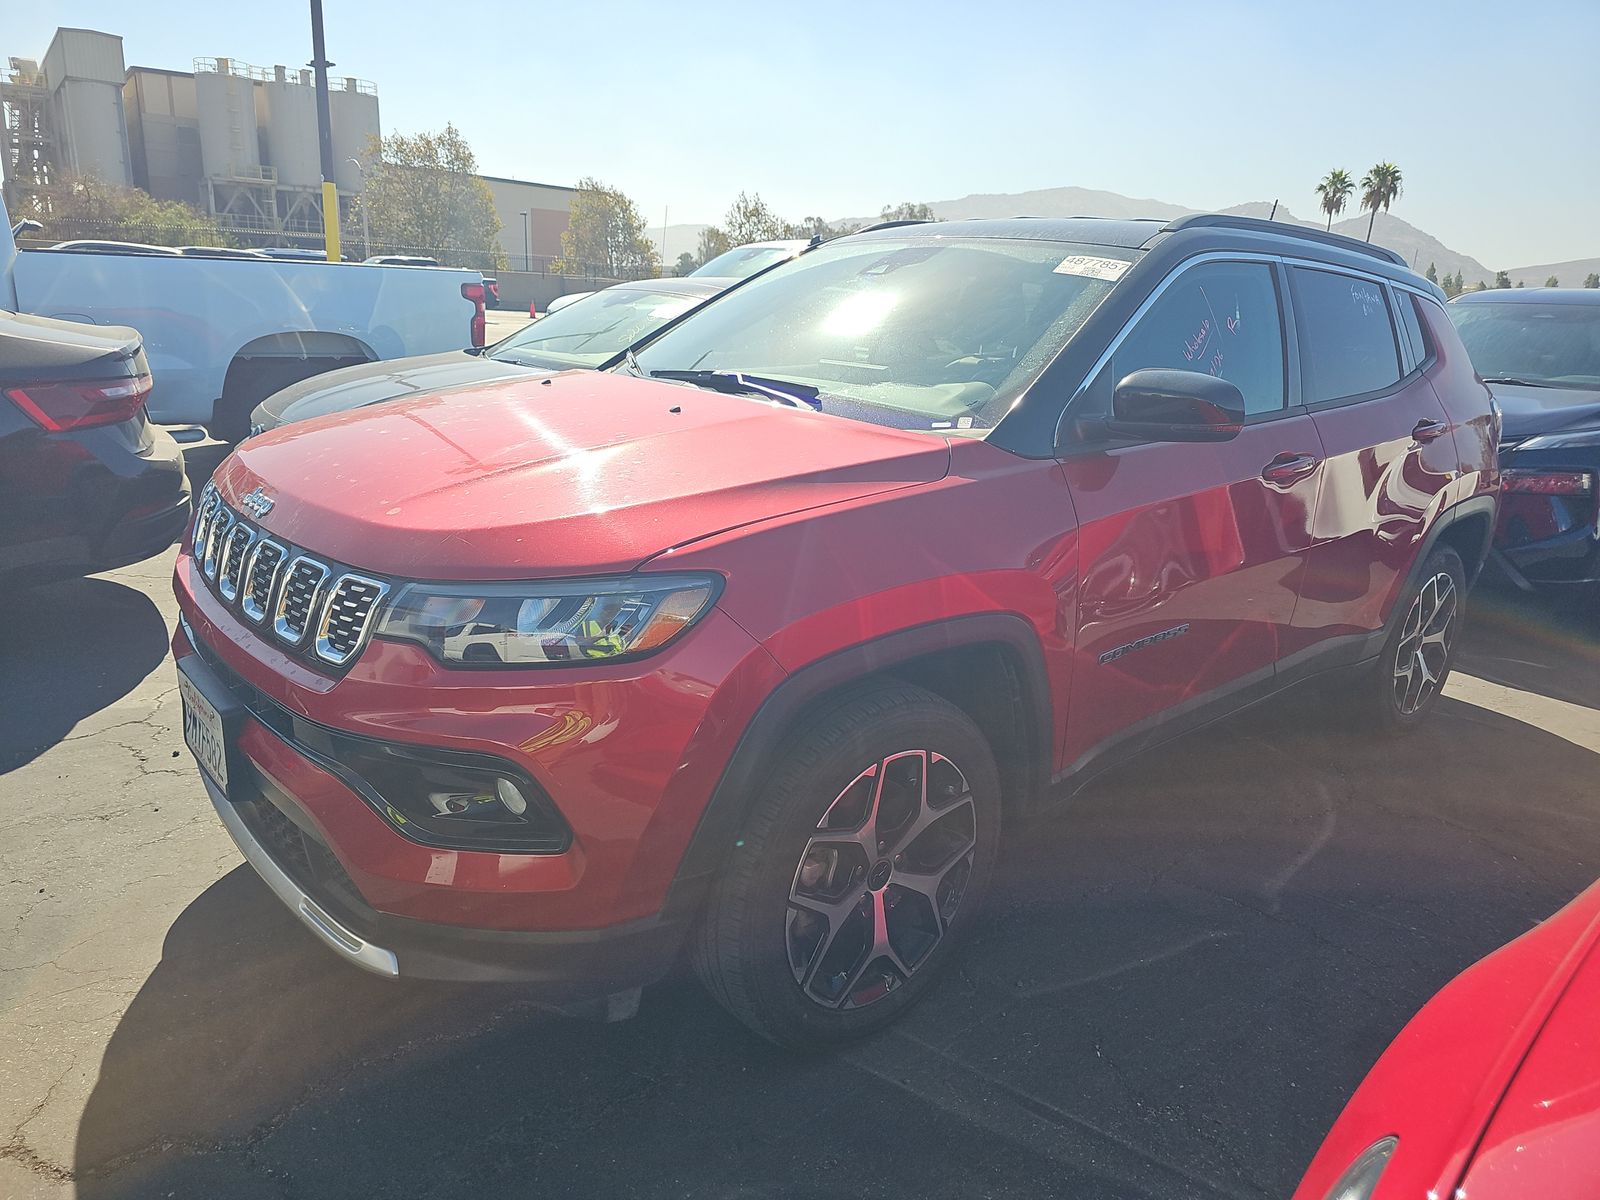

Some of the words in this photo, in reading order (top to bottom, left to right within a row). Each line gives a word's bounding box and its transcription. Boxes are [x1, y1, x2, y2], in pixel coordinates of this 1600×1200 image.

[1067, 257, 1129, 271] 4877857
[242, 487, 274, 518] Jeep
[1099, 623, 1189, 665] COMPASS
